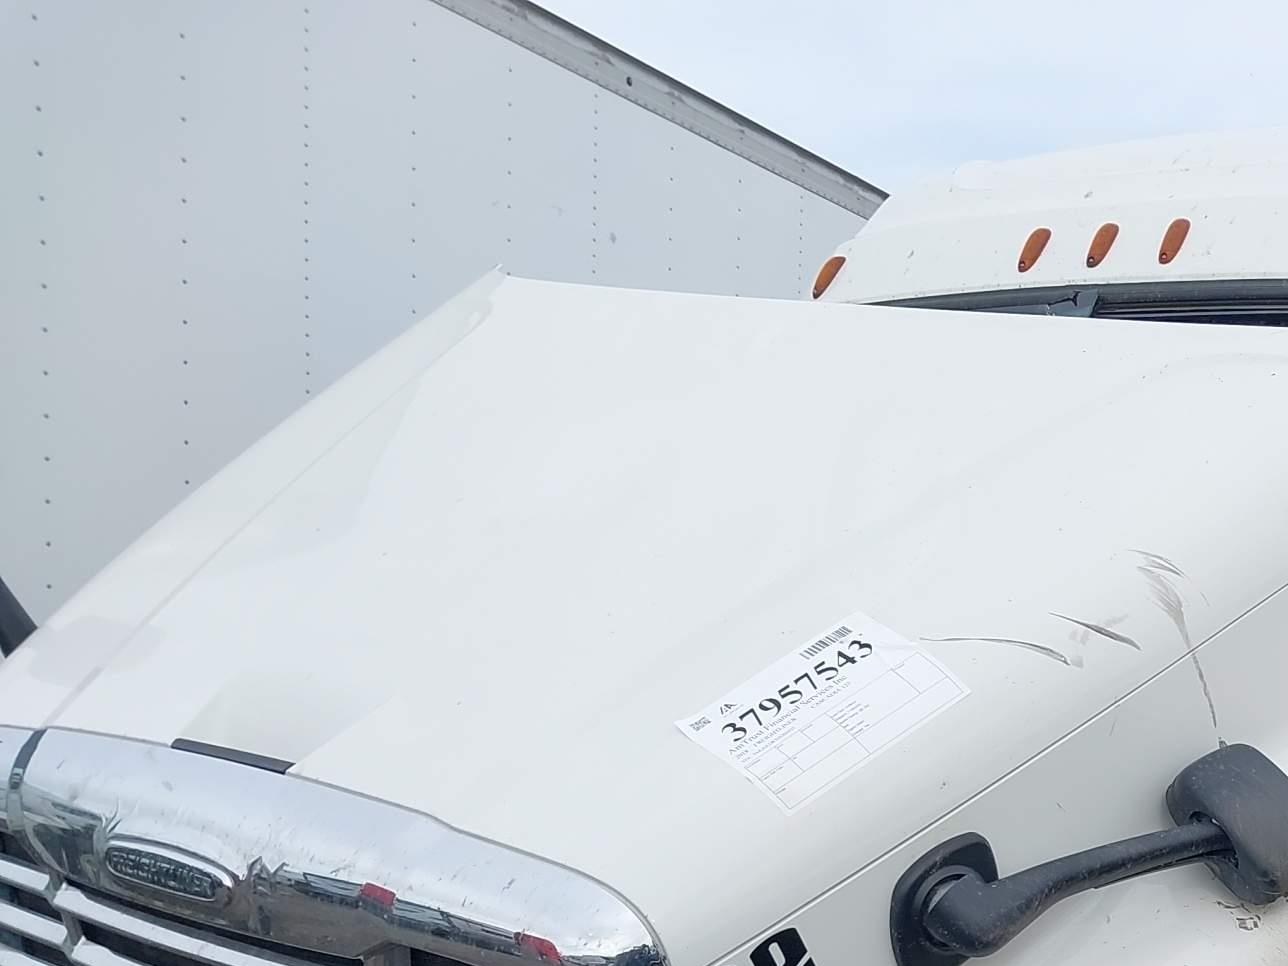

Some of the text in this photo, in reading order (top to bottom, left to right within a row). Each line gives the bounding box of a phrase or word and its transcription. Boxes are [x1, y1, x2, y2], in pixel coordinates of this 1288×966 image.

[721, 639, 873, 742] 37957543
[728, 728, 766, 756] AmTrust
[764, 703, 802, 732] Financial
[799, 682, 832, 707] Services
